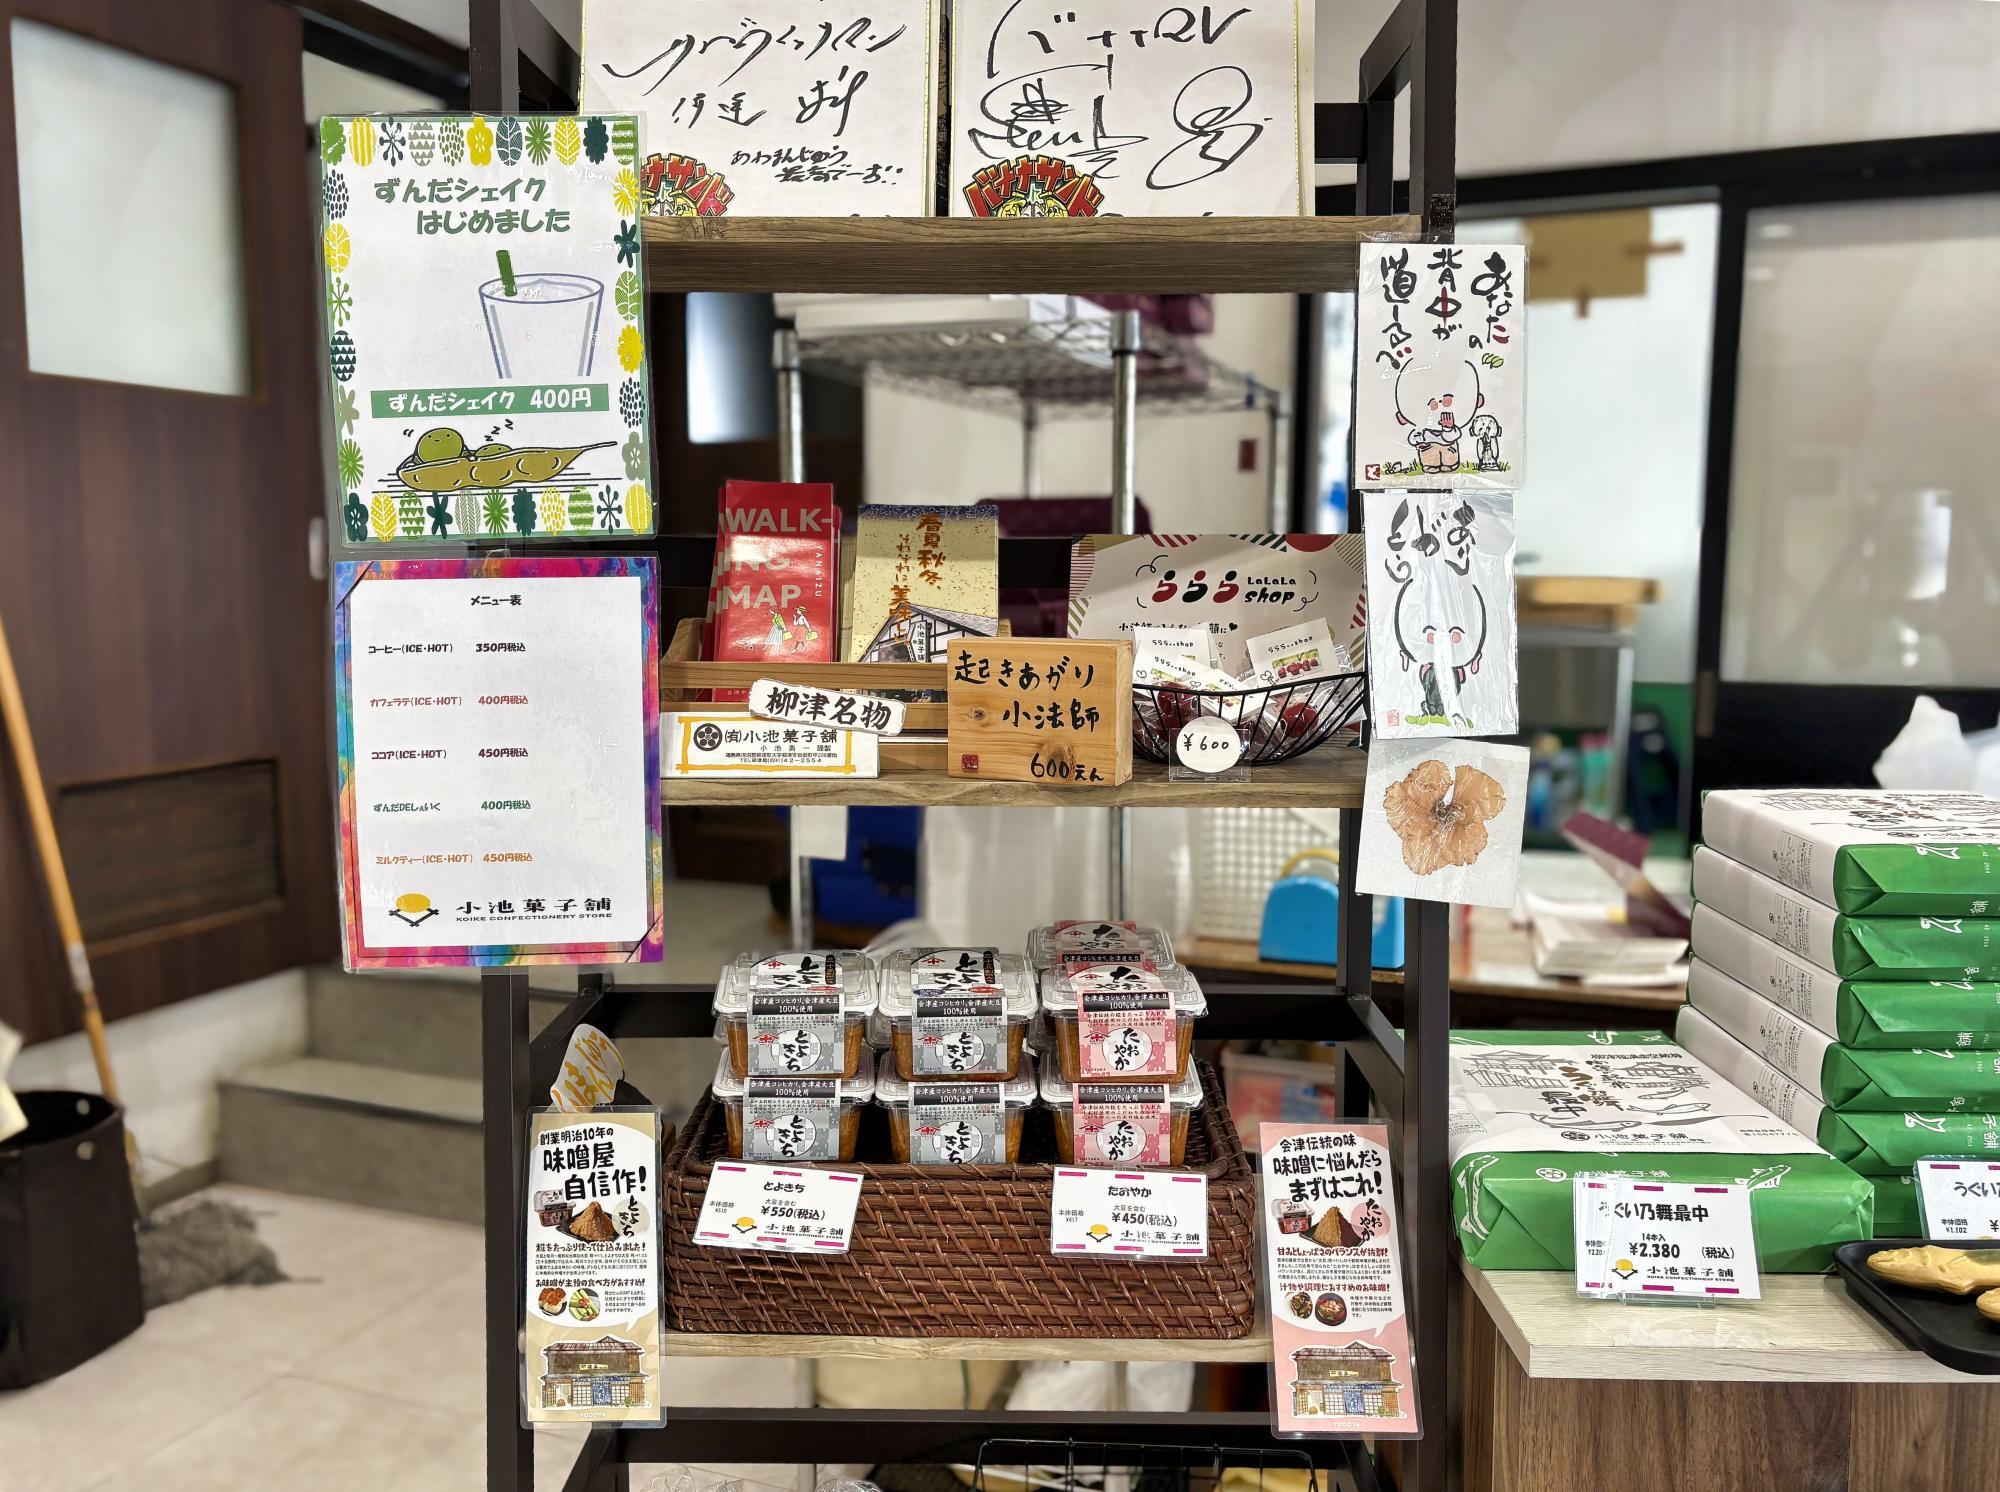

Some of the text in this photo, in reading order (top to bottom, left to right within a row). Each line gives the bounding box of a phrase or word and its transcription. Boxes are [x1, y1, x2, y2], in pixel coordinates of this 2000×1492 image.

[374, 177, 546, 203] ずんだシェイク
[963, 154, 1104, 217] バナナサンド
[416, 209, 571, 235] はじめました
[1425, 248, 1463, 341] 背中が
[1469, 252, 1514, 349] あなたの
[388, 388, 592, 412] ずんだシェイク 400円
[727, 508, 832, 533] WALK-
[815, 545, 823, 597] YANAIZU
[1247, 576, 1297, 585] LaLaLa
[470, 594, 521, 606] メニュー表
[724, 585, 801, 609] MAP
[1244, 587, 1295, 604] shop
[475, 642, 526, 653] 350円税込
[954, 650, 1094, 691] 起きあがり
[478, 695, 529, 706] 400円税込
[765, 686, 892, 730] 柳津名物
[1003, 698, 1100, 733] 小法師
[724, 729, 838, 744] (有)小池菓子舗
[1183, 733, 1229, 751] ¥600
[478, 748, 529, 759] 450円税込
[1031, 752, 1104, 782] 600えん
[373, 800, 531, 813] ずんだDEしぇいく 400円税込
[483, 852, 533, 863] 450円税込
[456, 897, 612, 915] 小池菓子舗
[779, 1005, 813, 1013] 100%使用
[1109, 1001, 1144, 1010] 100%使用
[775, 1088, 809, 1096] 100%使用
[940, 1095, 974, 1103] 100%使用
[1104, 1094, 1139, 1102] 100%使用
[540, 1127, 614, 1145] 創業明治10年の
[1279, 1134, 1357, 1153] 会津伝統の味
[543, 1142, 615, 1173] 味噌屋
[1273, 1150, 1382, 1176] 味噌に悩んだら
[565, 1166, 647, 1200] 自信作!
[763, 1181, 805, 1193] とよきち
[1289, 1171, 1382, 1202] まずはこれ!
[1953, 1181, 2000, 1198] うぐい
[1108, 1185, 1152, 1198] たおやか
[765, 1199, 797, 1207] 大豆を含む
[1114, 1204, 1146, 1212] 大豆を含む
[760, 1206, 826, 1221] ¥550(税込)
[1112, 1213, 1178, 1227] ¥450(税込)
[1941, 1218, 1968, 1226] 本体価格
[766, 1224, 844, 1236] 小池菓子舗
[1642, 1233, 1666, 1242] 14本入
[1277, 1247, 1388, 1257] 甘みとしょっぱさのバランスが抜群!
[1702, 1247, 1735, 1259] (税込)
[1647, 1265, 1734, 1278] 小池菓子舗
[536, 1278, 645, 1287] お味噌が主役の食べ方がおすすめ!
[1280, 1283, 1390, 1292] 汁物や調理におすすめのお味噌!
